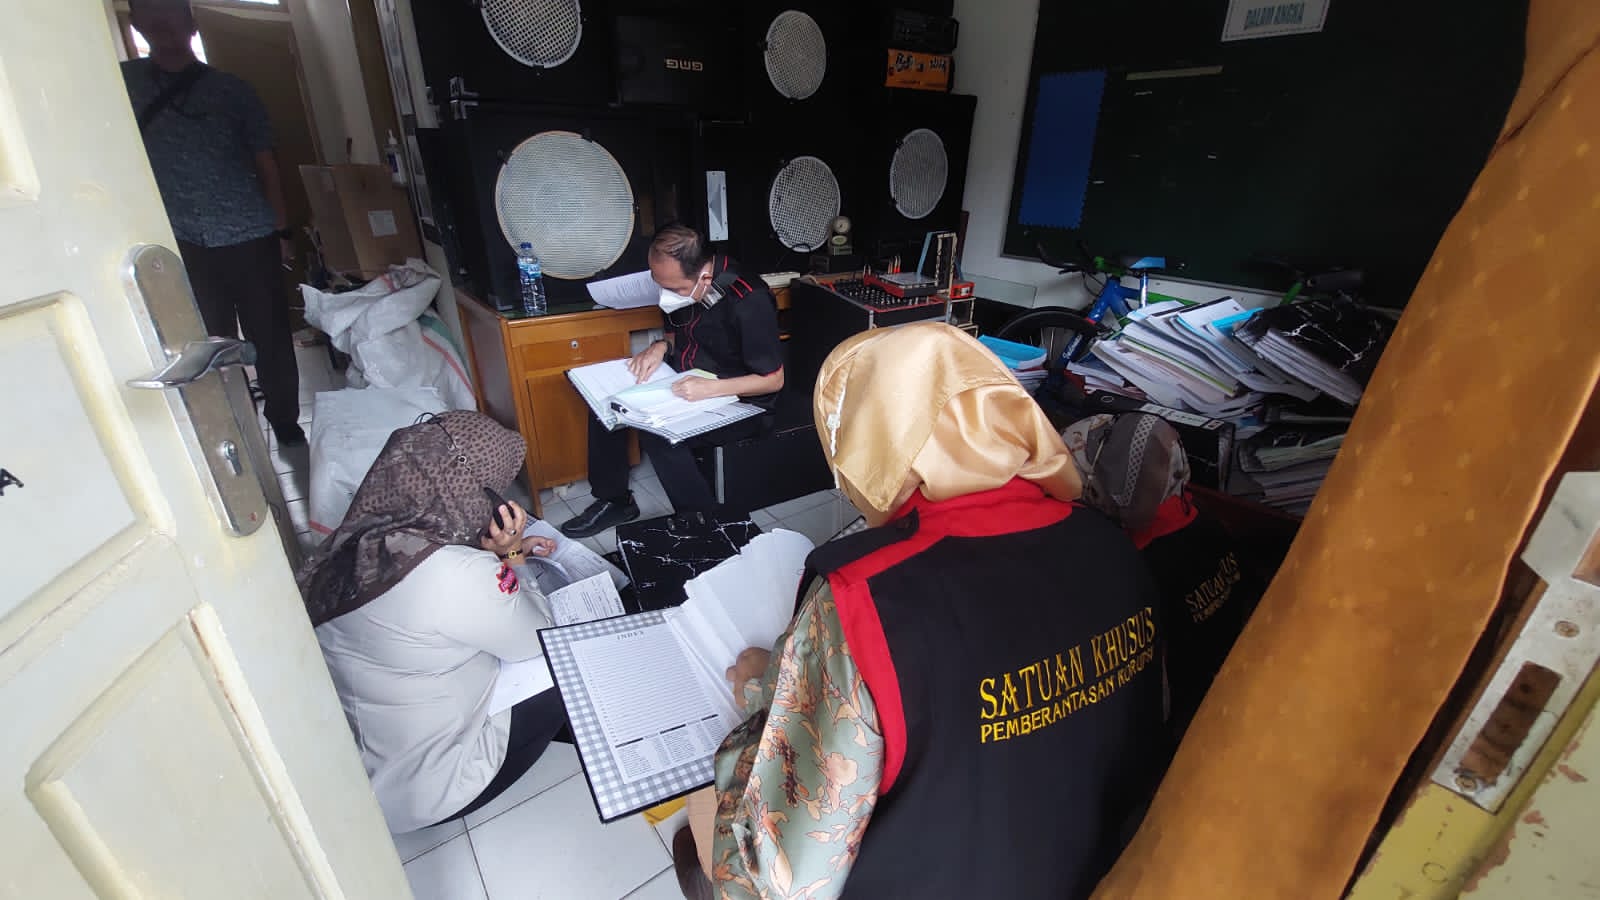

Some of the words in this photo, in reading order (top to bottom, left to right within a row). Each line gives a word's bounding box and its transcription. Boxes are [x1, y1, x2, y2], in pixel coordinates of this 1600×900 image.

[979, 644, 1085, 719] SATUAN
[1090, 606, 1156, 678] KHUSUS
[980, 675, 1116, 744] PEMBERANTASAN
